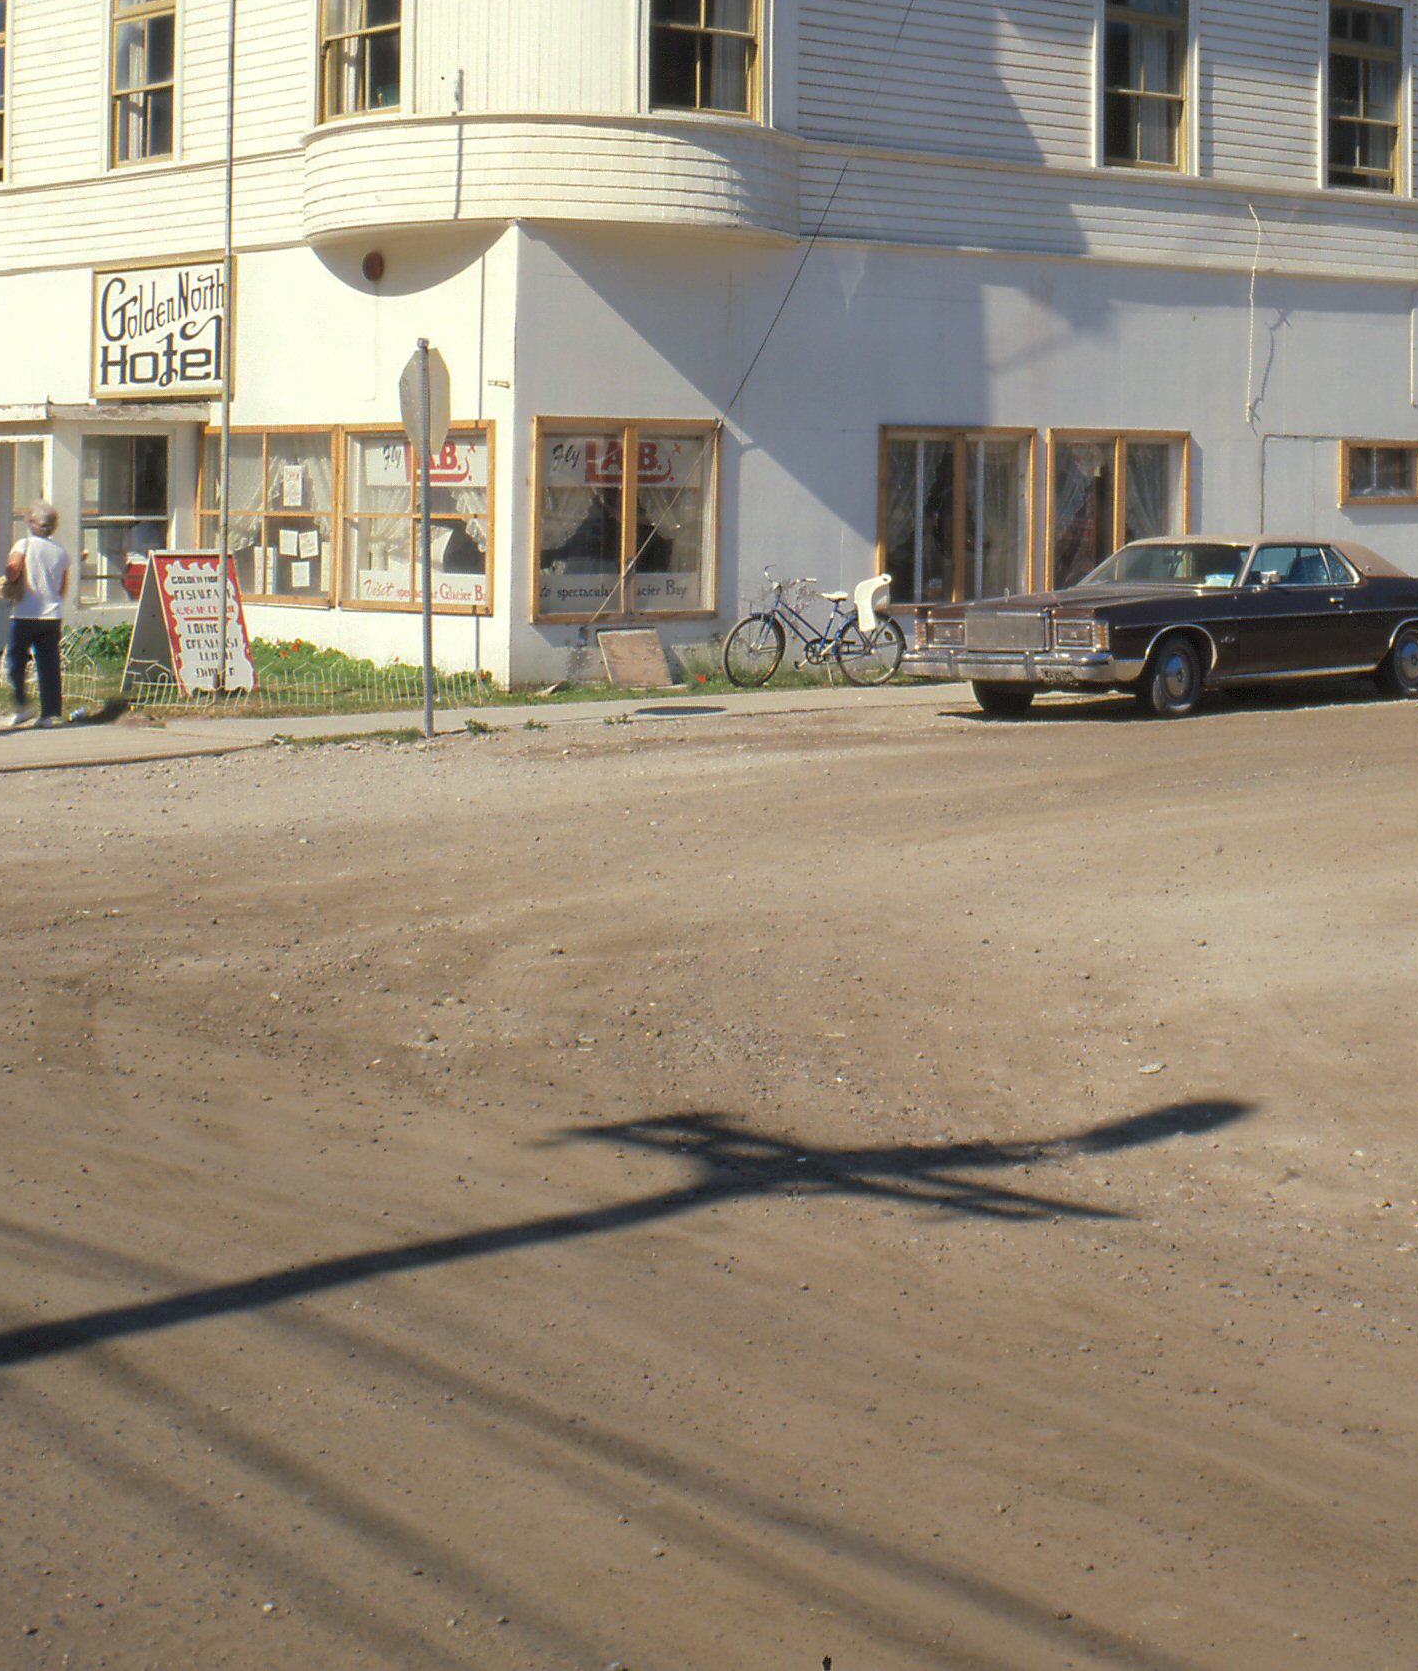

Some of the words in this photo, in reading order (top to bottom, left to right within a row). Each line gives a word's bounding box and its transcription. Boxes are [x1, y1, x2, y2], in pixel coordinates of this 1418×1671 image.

[101, 276, 176, 342] Golden
[177, 267, 225, 320] North
[100, 314, 223, 388] Hotel
[552, 443, 582, 472] Fly
[666, 579, 687, 599] Bay
